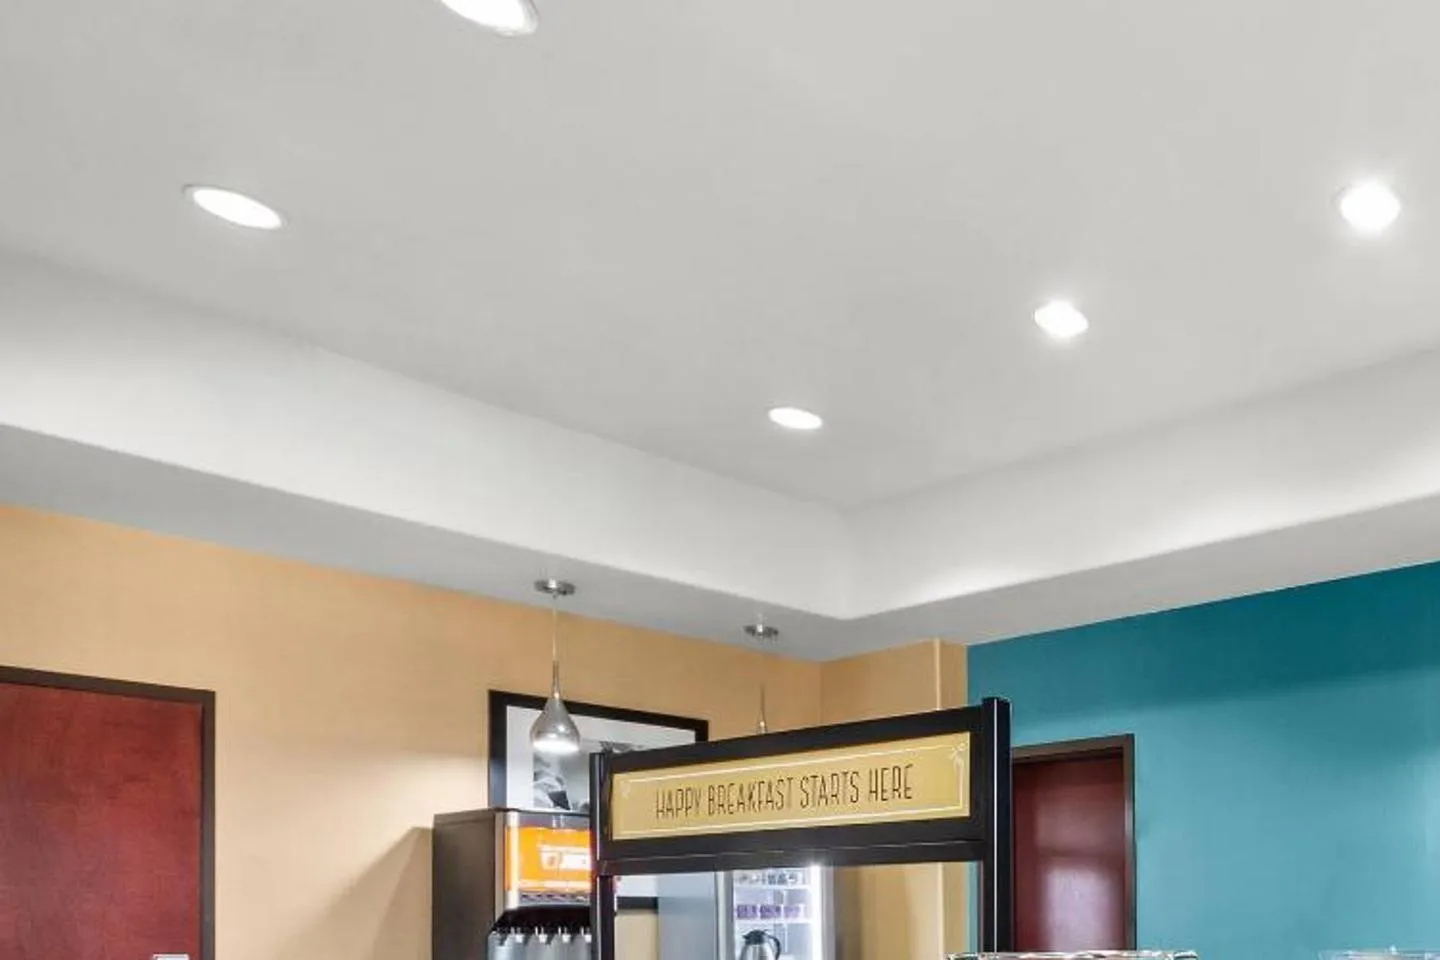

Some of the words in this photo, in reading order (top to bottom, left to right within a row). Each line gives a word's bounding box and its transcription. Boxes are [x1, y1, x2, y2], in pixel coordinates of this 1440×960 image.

[656, 786, 702, 820] HAPPY
[707, 776, 794, 817] BREAKFAST
[800, 770, 860, 810] STARTS
[868, 763, 914, 803] HERE
